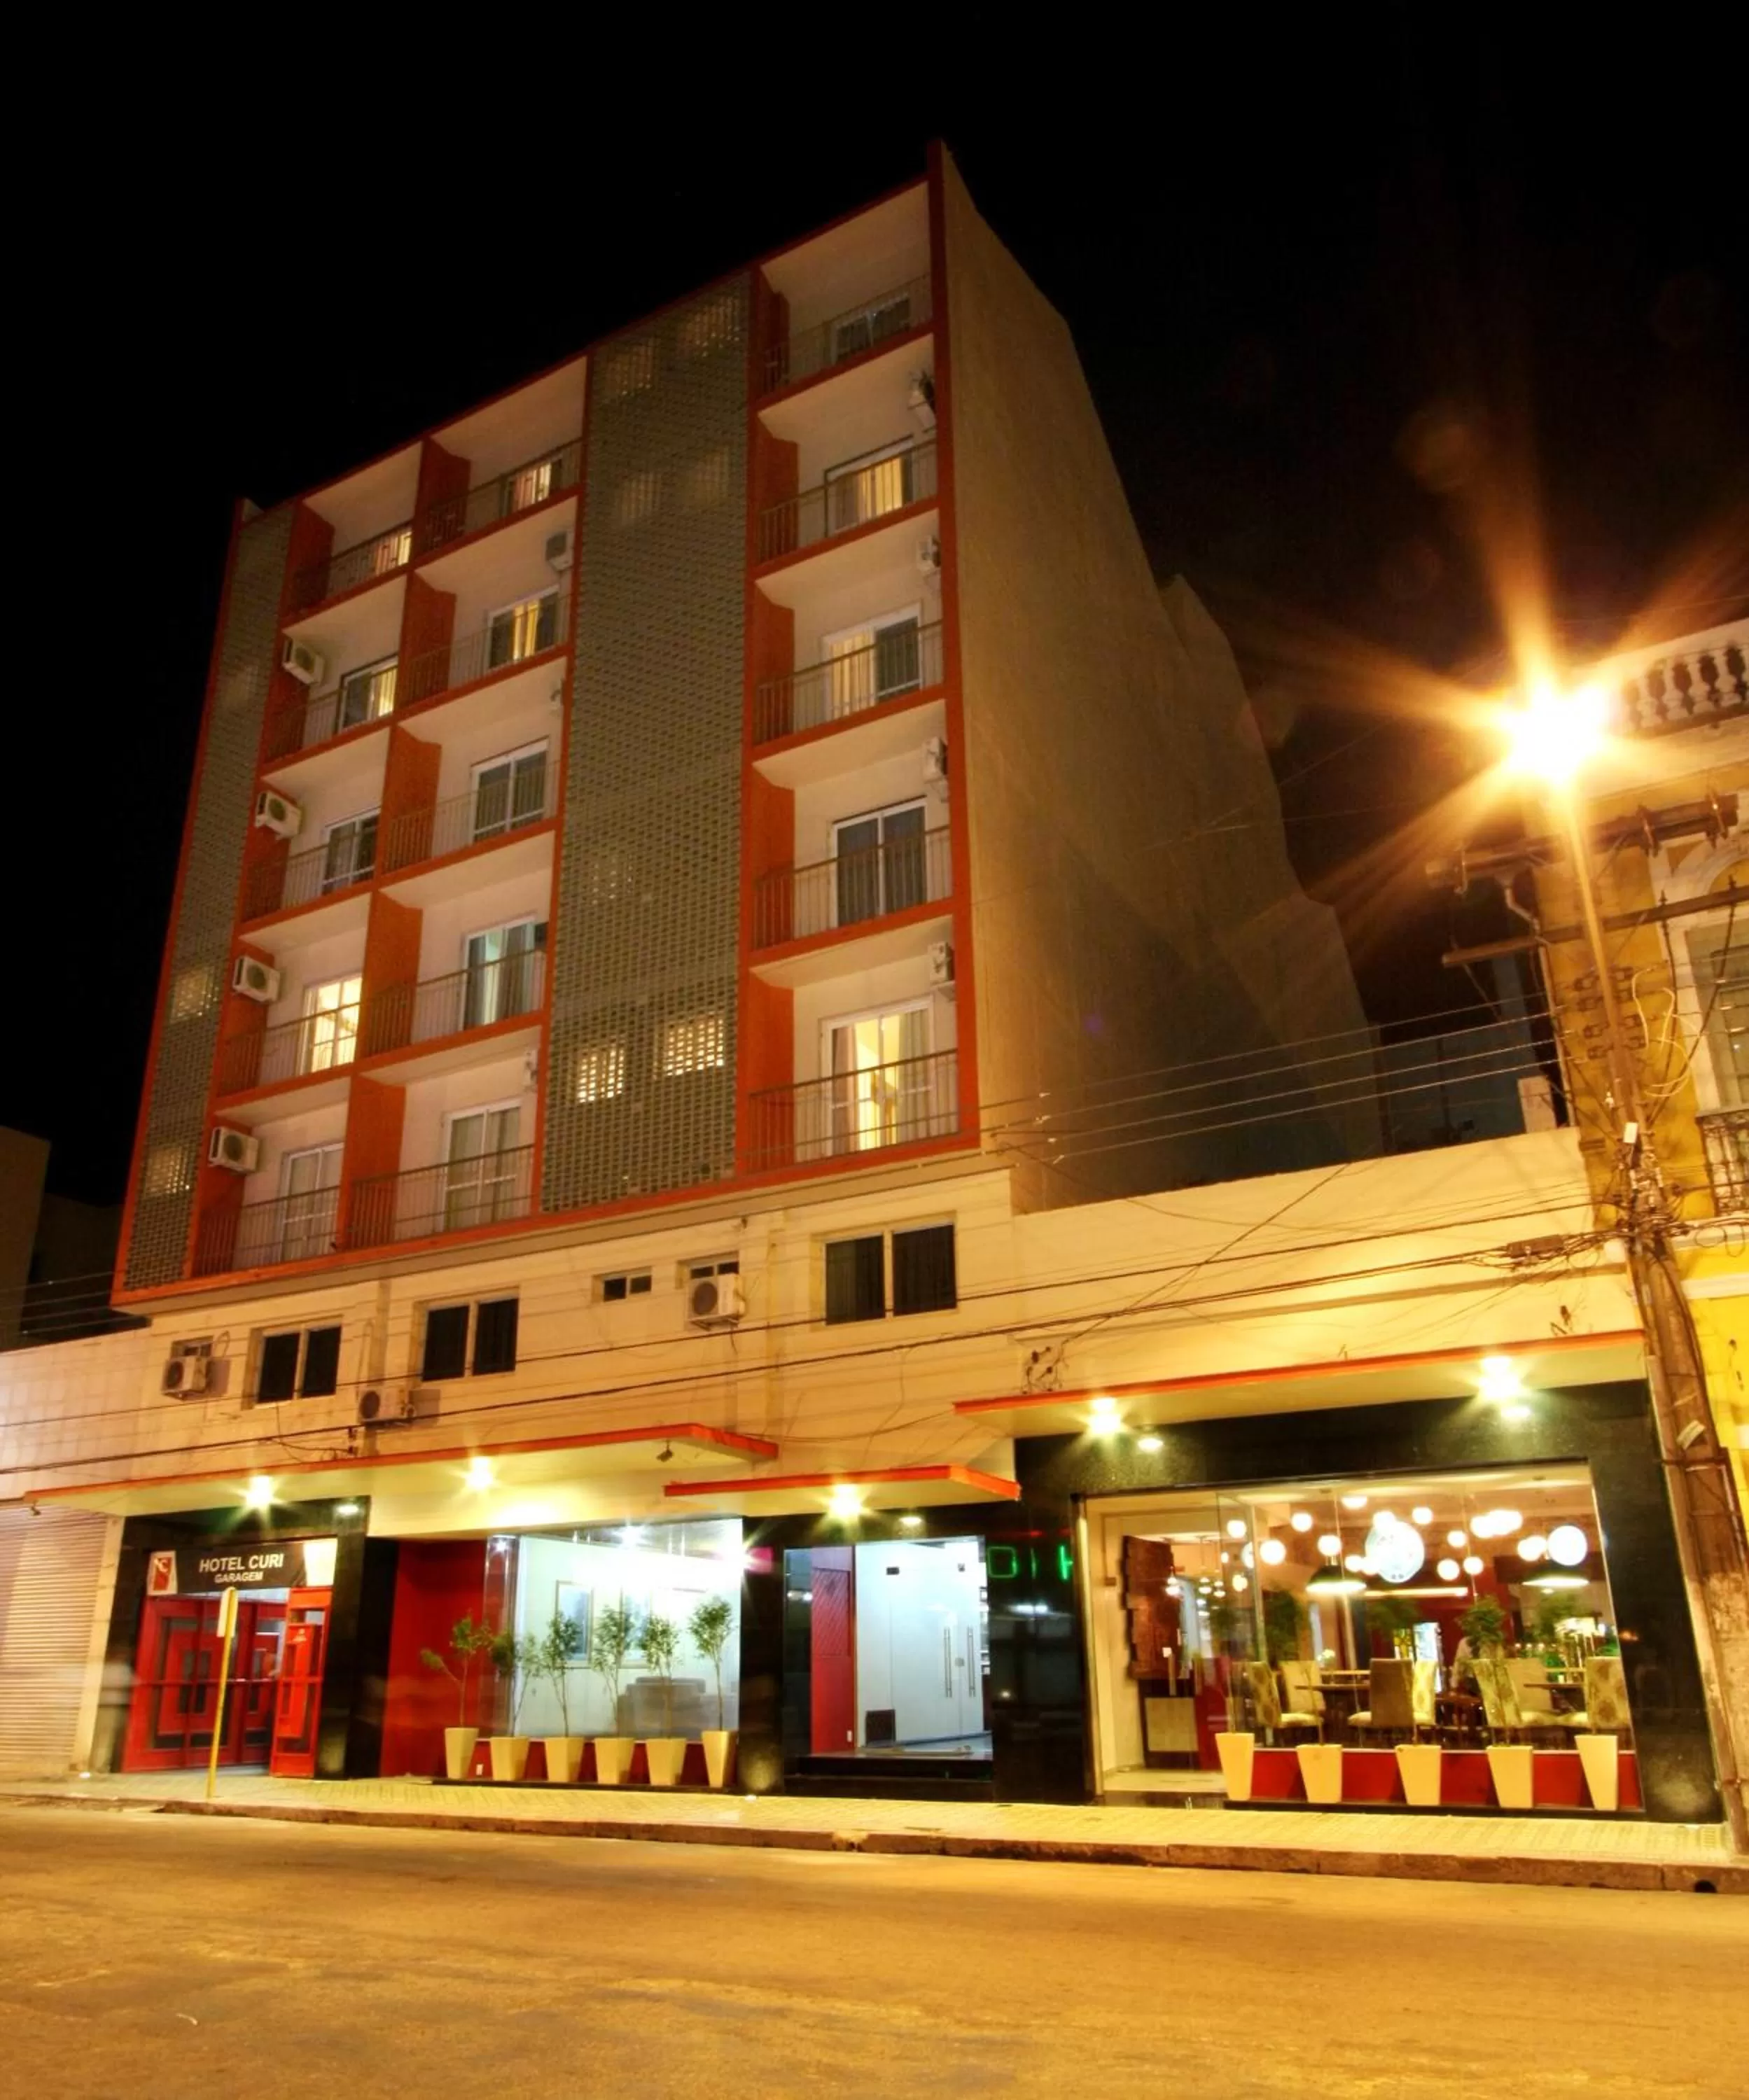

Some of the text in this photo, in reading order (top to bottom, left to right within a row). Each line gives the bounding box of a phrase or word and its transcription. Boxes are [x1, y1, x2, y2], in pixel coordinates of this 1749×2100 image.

[199, 1553, 284, 1573] HOTEL CURI
[214, 1571, 264, 1583] GARAGEM
